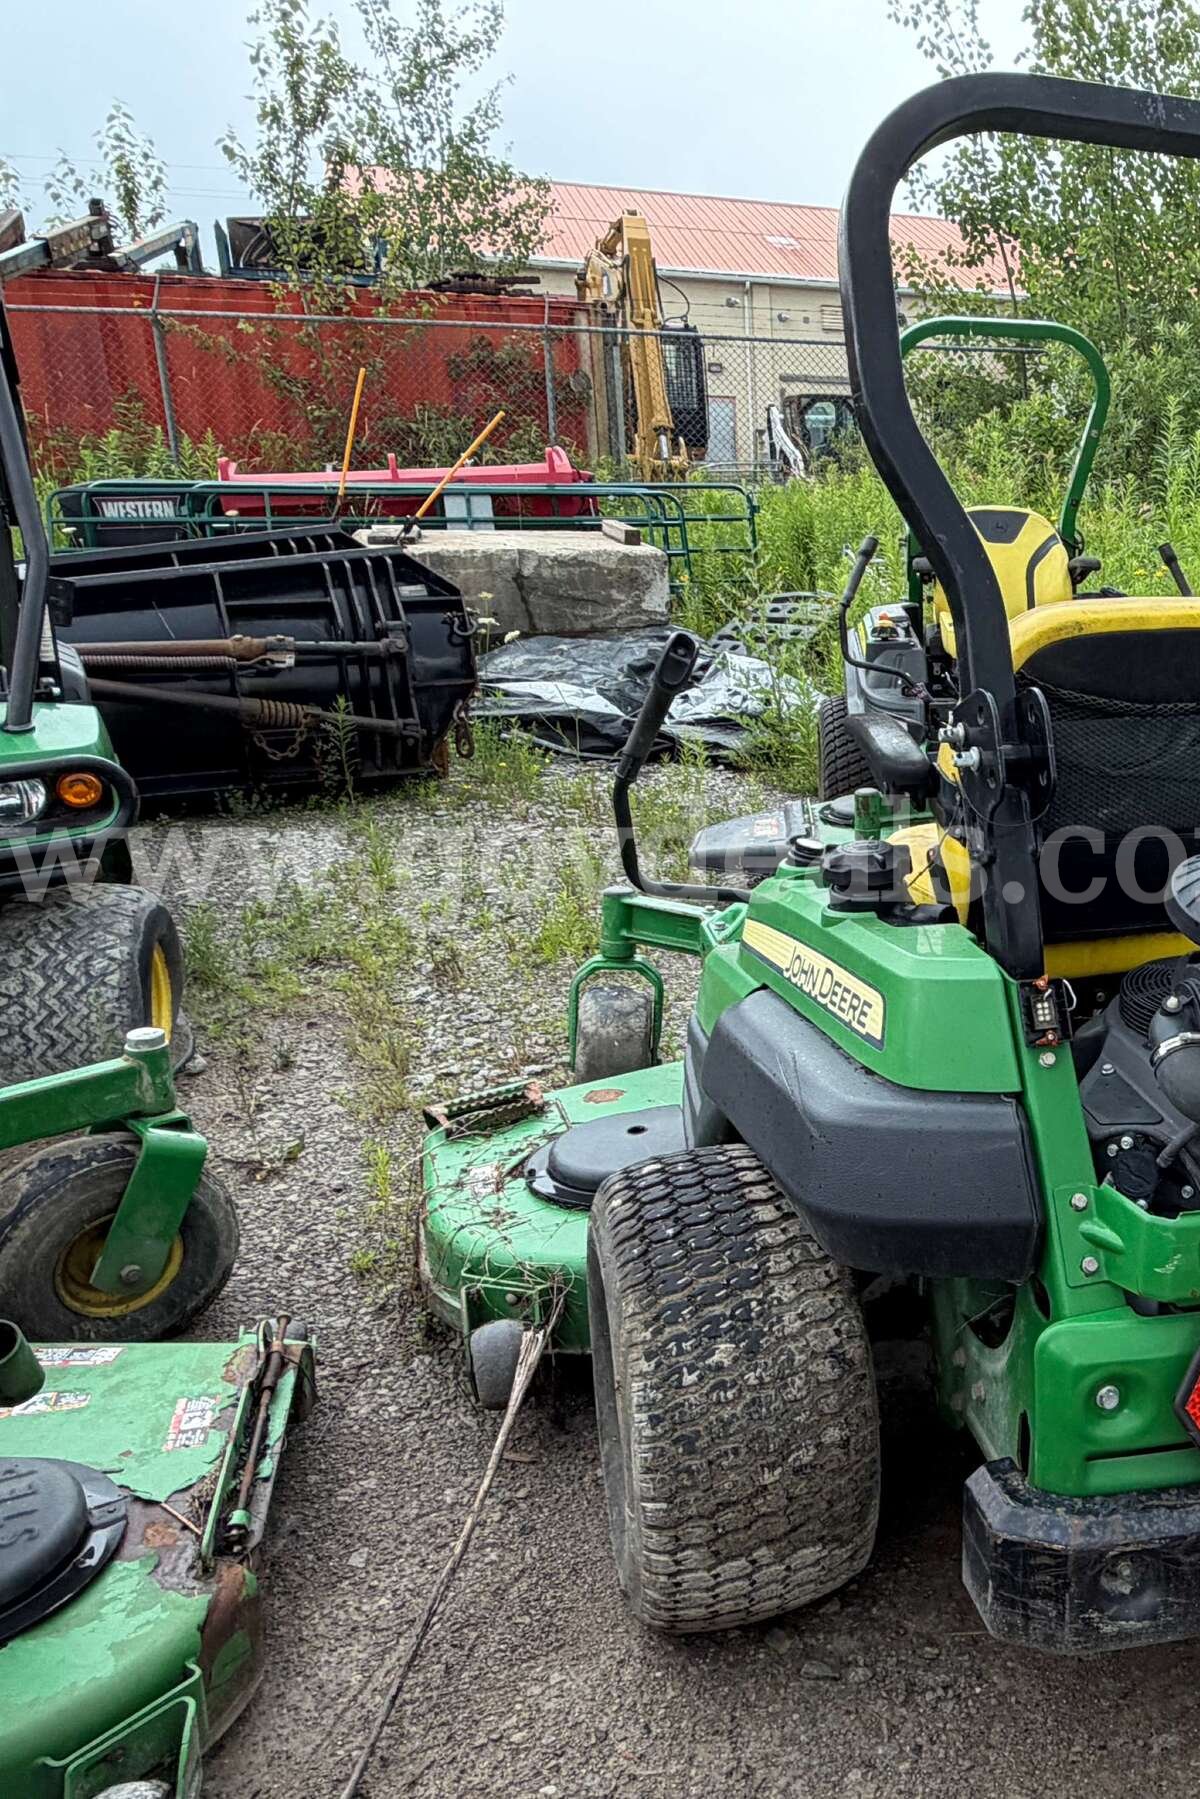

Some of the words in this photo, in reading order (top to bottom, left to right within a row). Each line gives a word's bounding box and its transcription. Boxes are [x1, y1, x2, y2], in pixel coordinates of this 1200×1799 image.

[101, 500, 176, 518] WESTERN
[785, 945, 821, 994] JOHN
[818, 967, 873, 1029] DEERE
